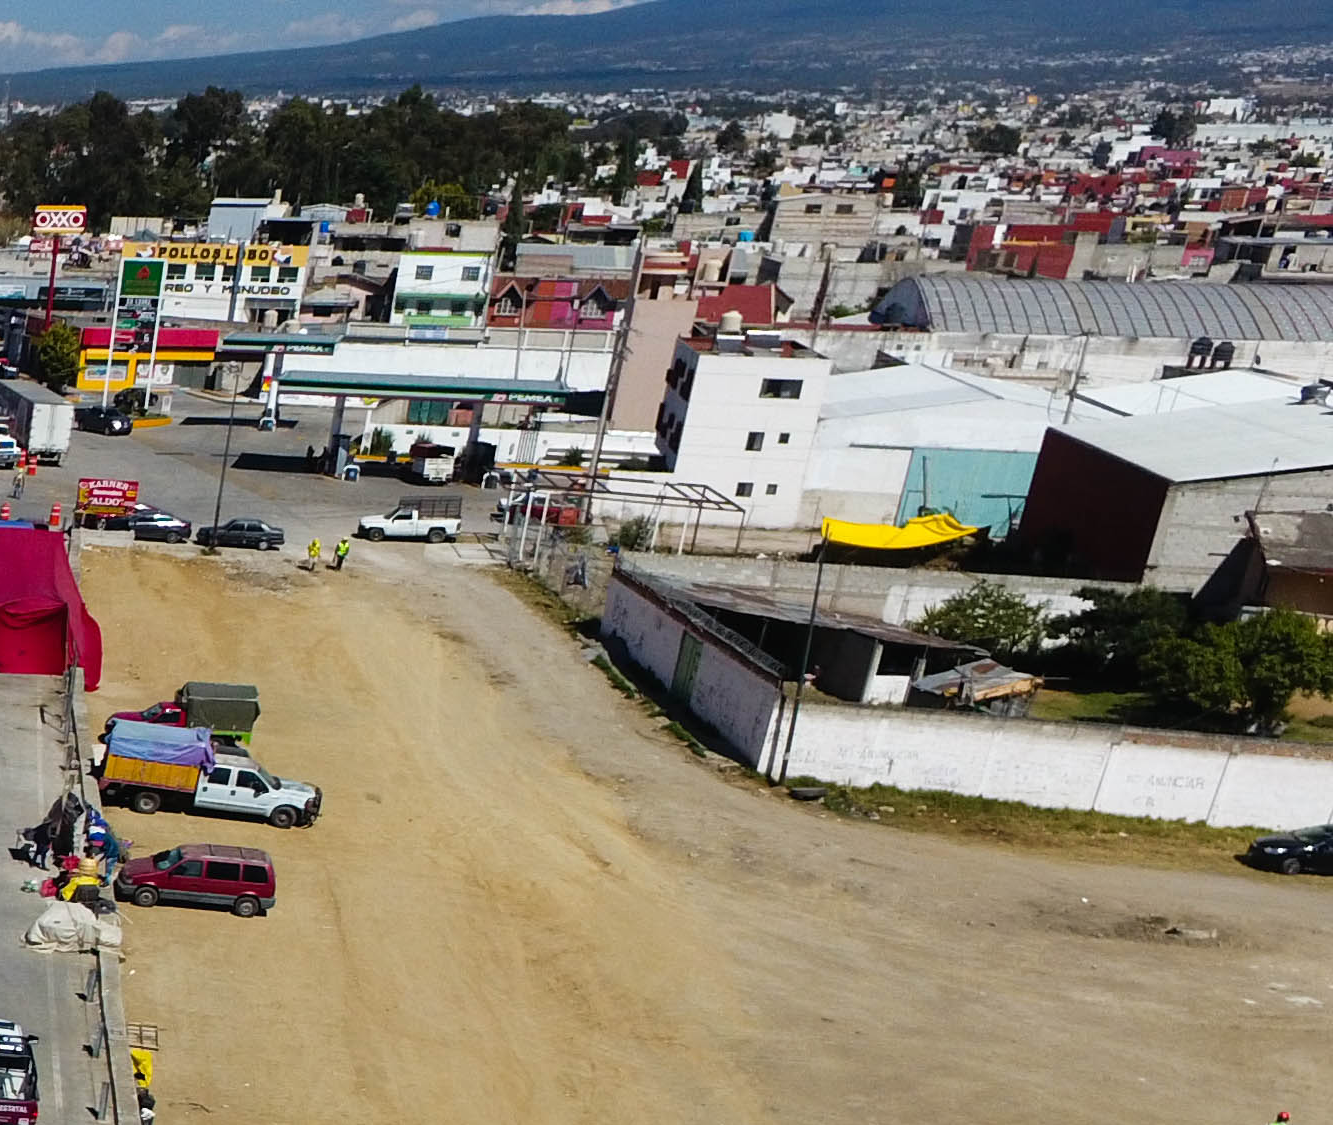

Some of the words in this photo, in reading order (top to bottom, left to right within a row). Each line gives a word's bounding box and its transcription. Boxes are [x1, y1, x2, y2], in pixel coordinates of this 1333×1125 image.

[35, 211, 84, 228] OXXO
[157, 246, 221, 261] POLLOS
[225, 248, 269, 261] LBO
